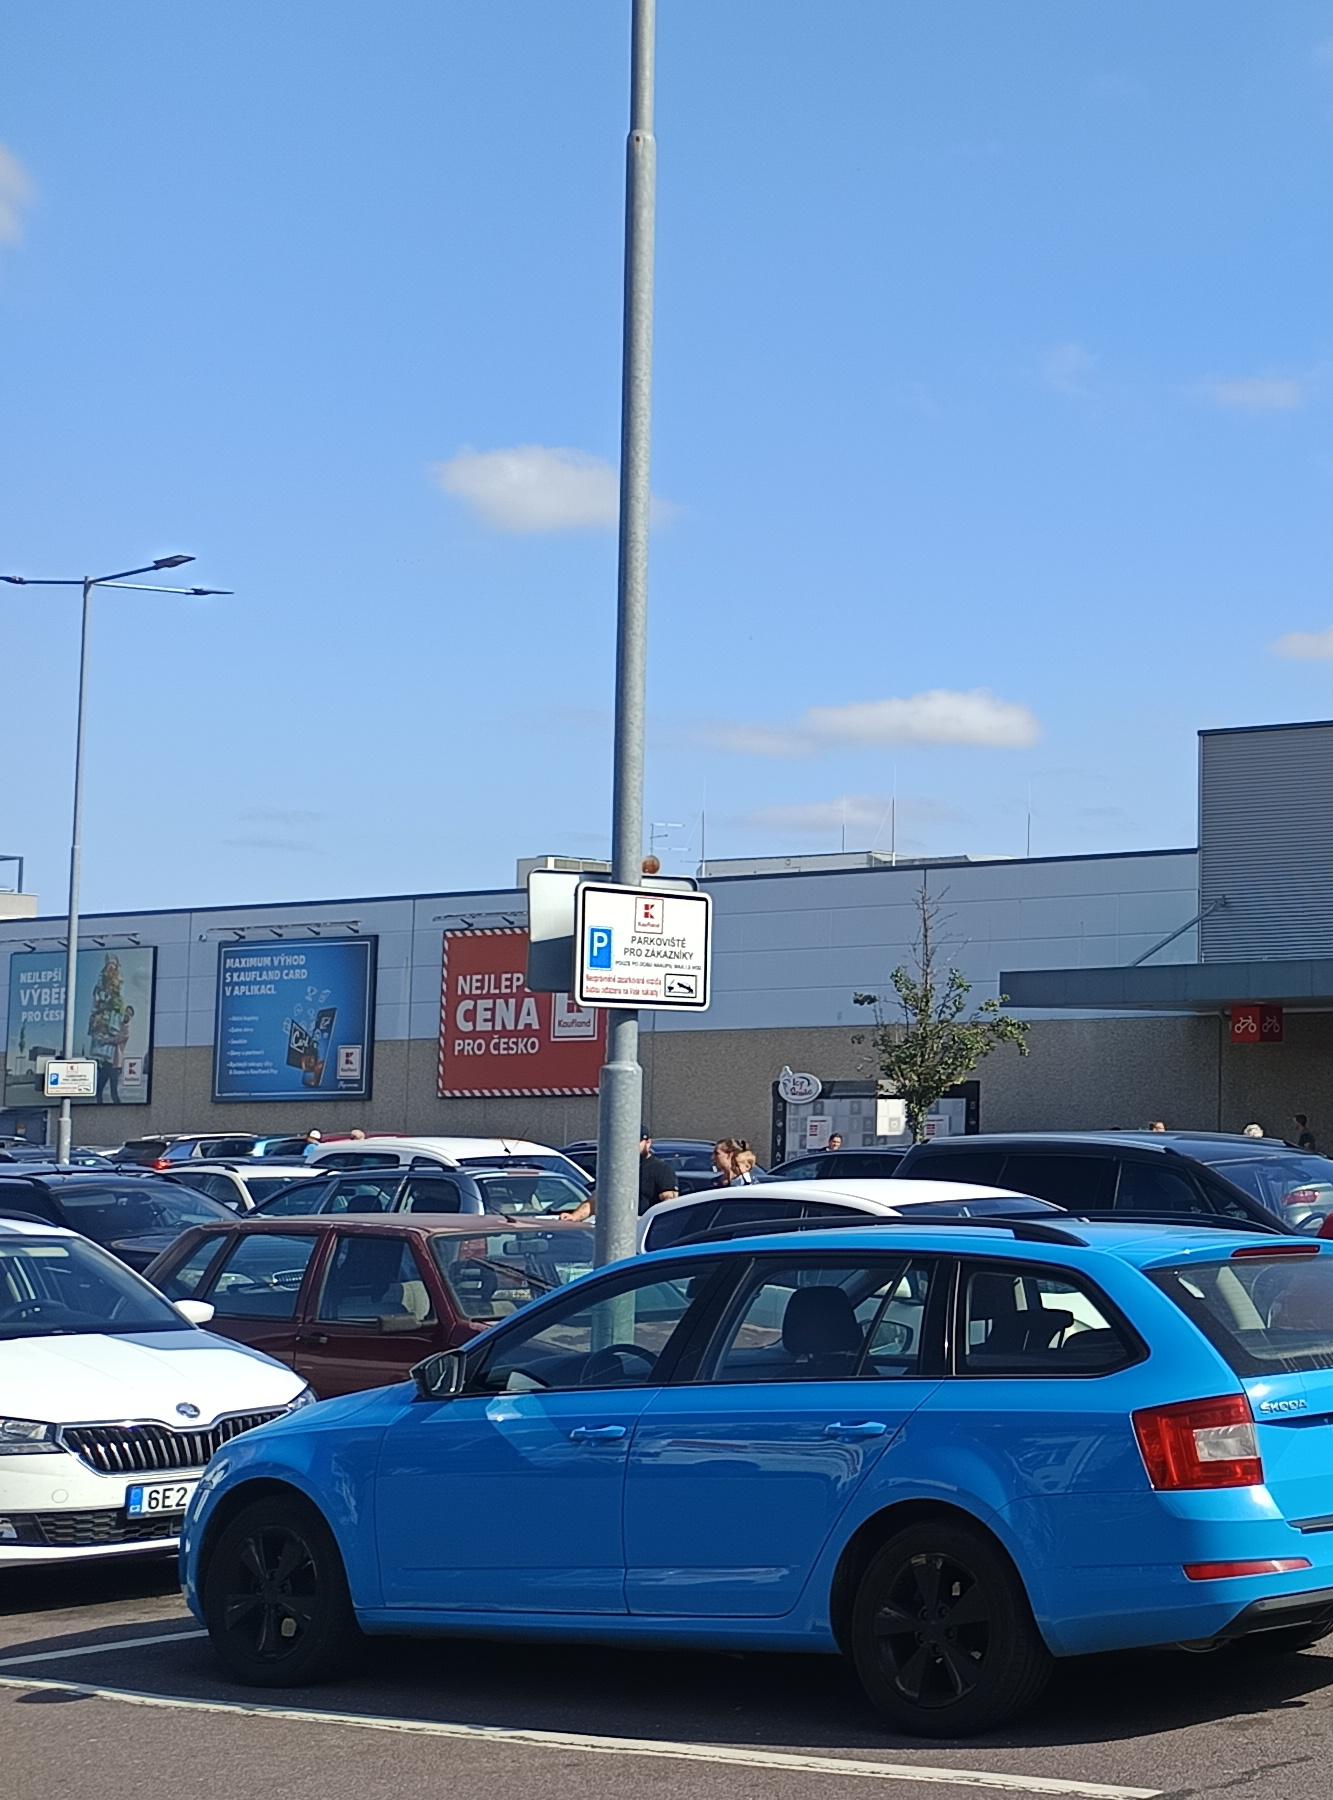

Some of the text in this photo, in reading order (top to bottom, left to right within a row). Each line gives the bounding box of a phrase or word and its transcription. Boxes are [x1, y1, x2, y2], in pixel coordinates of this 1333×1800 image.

[593, 931, 608, 957] P
[631, 935, 686, 948] PARKOVIŠTĚ
[226, 953, 306, 968] MAXIMUM VÝHOD
[623, 947, 694, 960] PRO ZÁKAZNÍKY
[20, 968, 62, 983] NEJLEPŠÍ
[225, 968, 308, 983] S KAUFLAND CARD
[225, 986, 232, 996] V
[457, 973, 532, 995] NEJLEP
[21, 1007, 64, 1022] PRO ČES
[455, 997, 541, 1032] CENA
[557, 1018, 591, 1028] Kaufland
[454, 1034, 539, 1056] PRO ČESKO
[147, 1486, 188, 1510] 6E2
